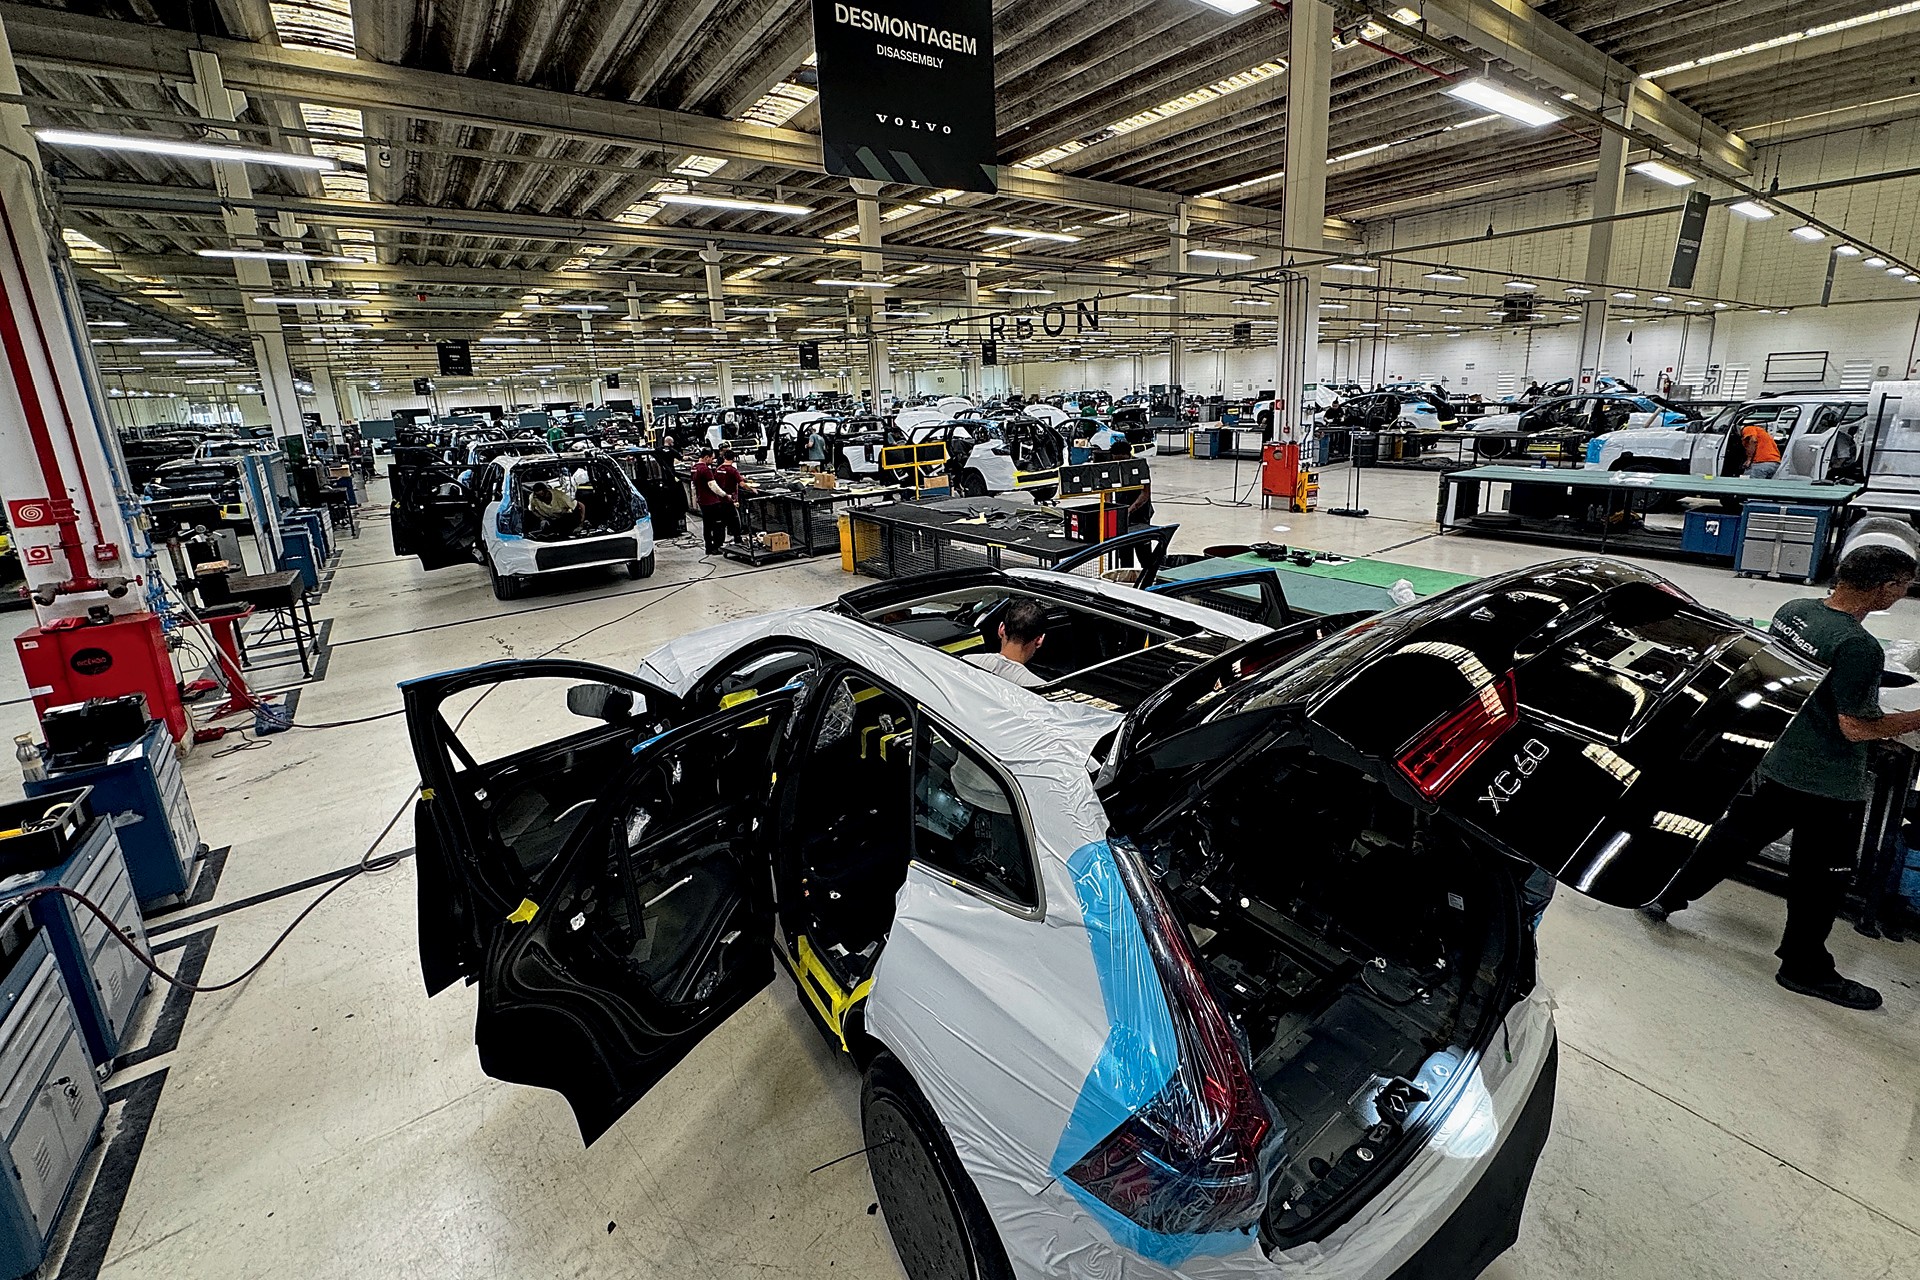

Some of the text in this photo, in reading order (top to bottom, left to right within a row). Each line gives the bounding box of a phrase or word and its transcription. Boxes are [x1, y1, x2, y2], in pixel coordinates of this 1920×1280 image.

[834, 2, 977, 56] DESMONTAGEM
[876, 43, 944, 69] DISASSEMBLY
[875, 113, 952, 135] VOLVO
[1477, 738, 1550, 816] XC60
